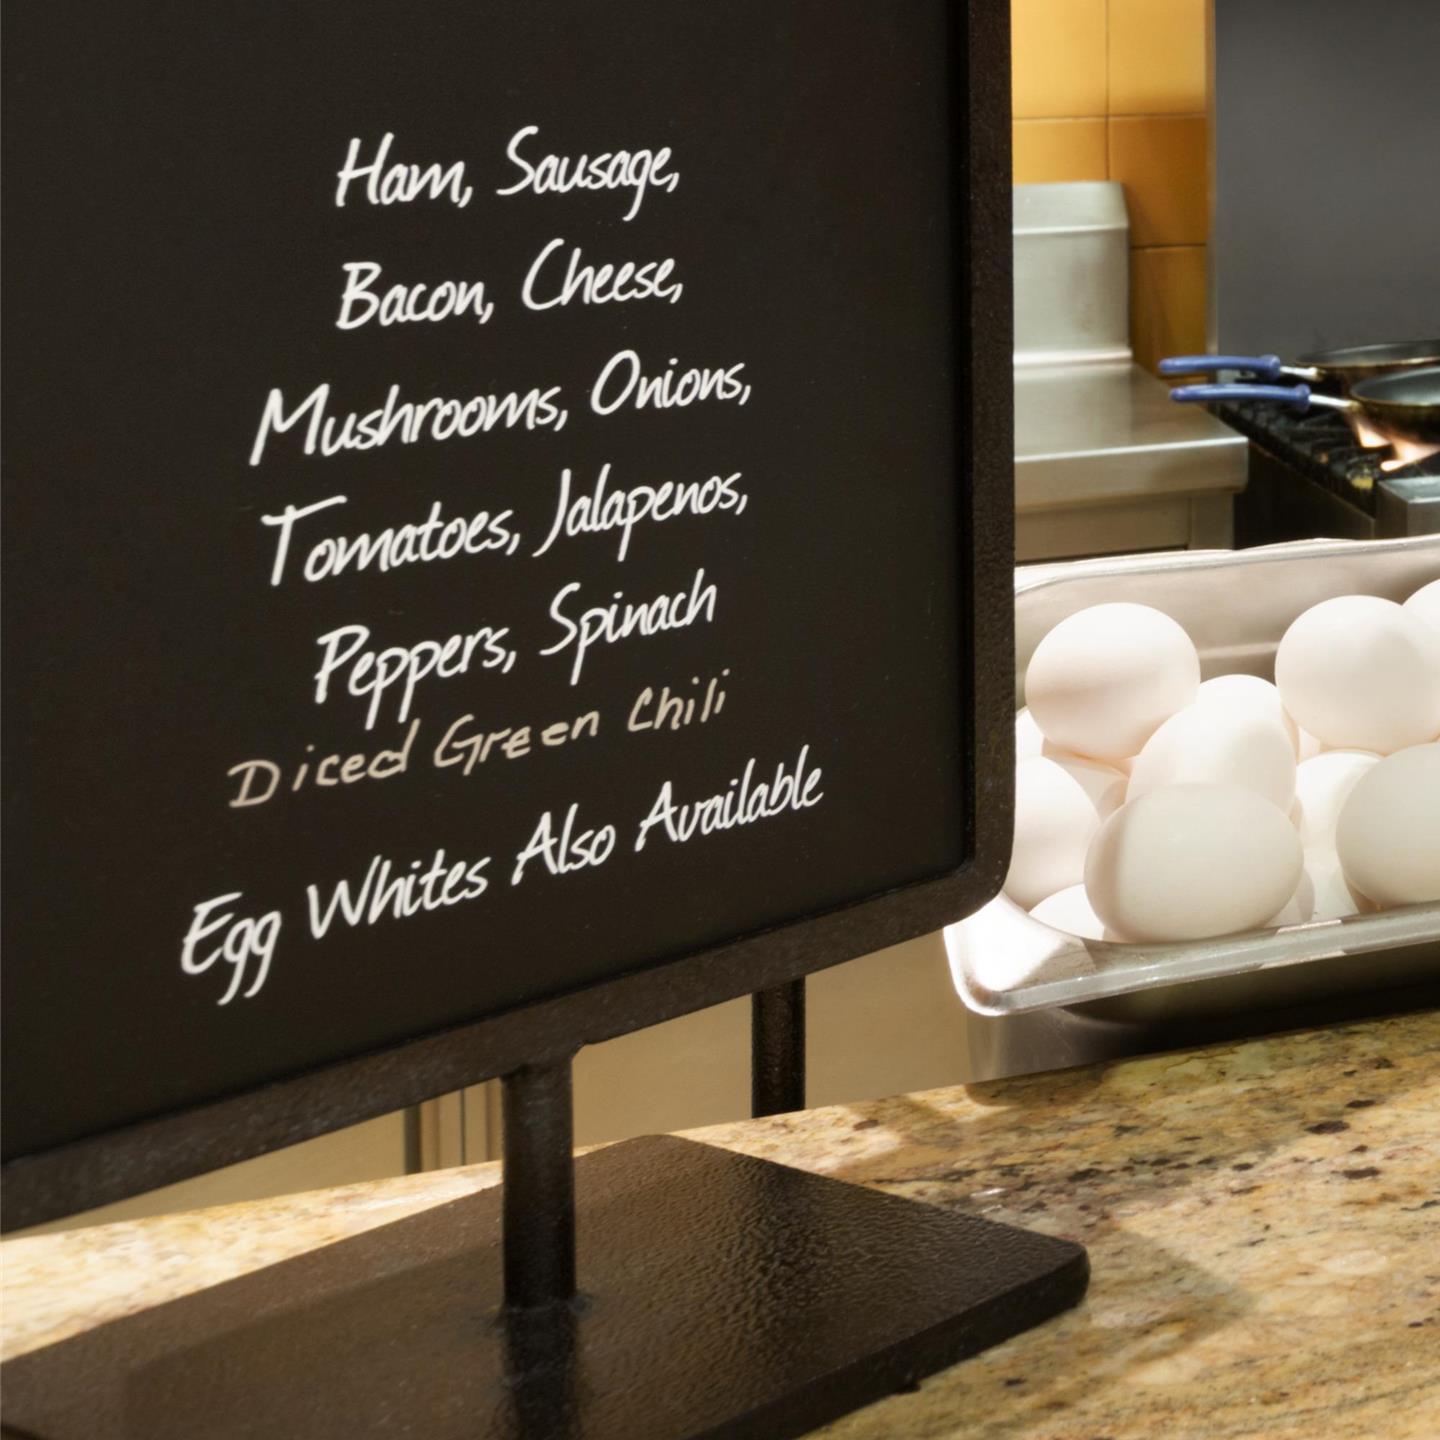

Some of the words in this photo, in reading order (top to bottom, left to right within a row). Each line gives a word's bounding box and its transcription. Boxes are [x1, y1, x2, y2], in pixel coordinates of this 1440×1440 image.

[334, 131, 474, 209] Ham,
[495, 125, 681, 222] Sausage,
[335, 257, 495, 331] Bacon,
[521, 237, 684, 311] Cheese,
[248, 382, 569, 467] Mushrooms,
[590, 348, 752, 416] Onions,
[260, 494, 521, 587] Tomatoes,
[531, 462, 749, 563] Jalapenos,
[313, 623, 517, 731] Peppers,
[538, 567, 718, 687] Spinach
[226, 716, 422, 809] Diced
[432, 709, 600, 777] Green
[627, 669, 731, 733] Chili
[180, 891, 283, 1006] Egg
[306, 848, 492, 940] Whites
[510, 802, 617, 886] Also
[634, 743, 824, 853] Available
